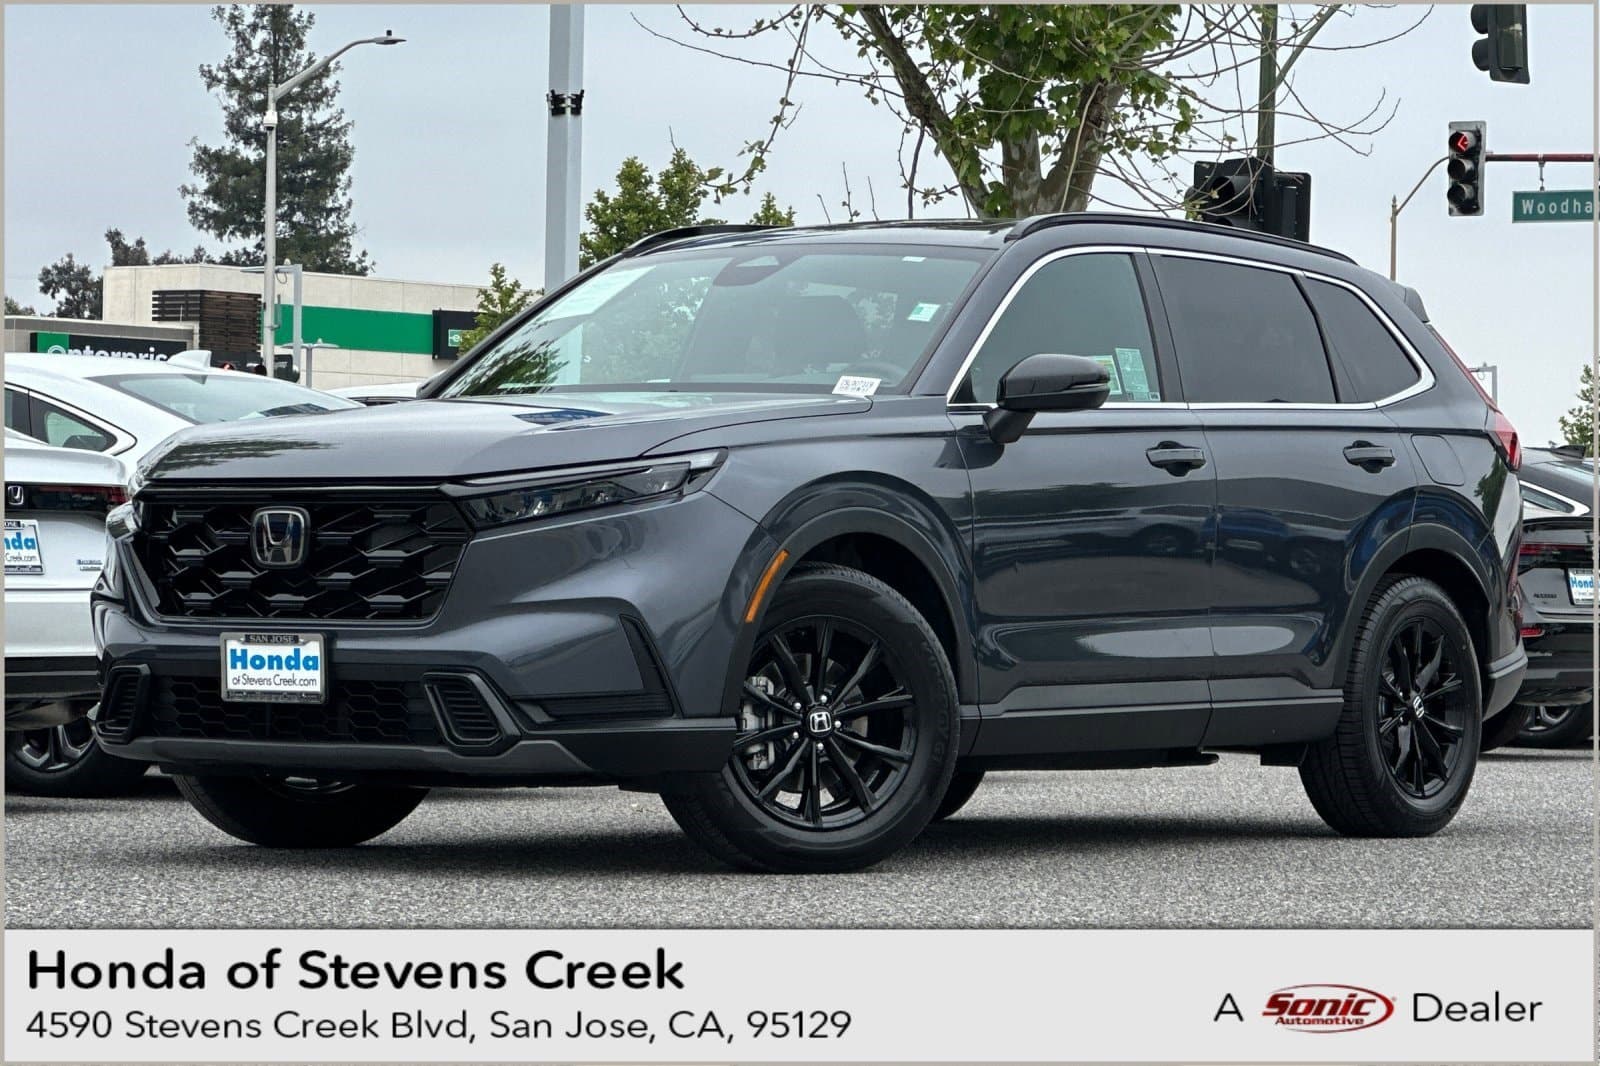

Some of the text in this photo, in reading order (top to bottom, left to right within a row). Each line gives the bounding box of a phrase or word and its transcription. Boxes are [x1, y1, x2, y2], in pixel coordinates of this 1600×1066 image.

[1521, 198, 1593, 214] Woodha
[1571, 576, 1594, 588] Hond
[230, 648, 319, 670] Honda
